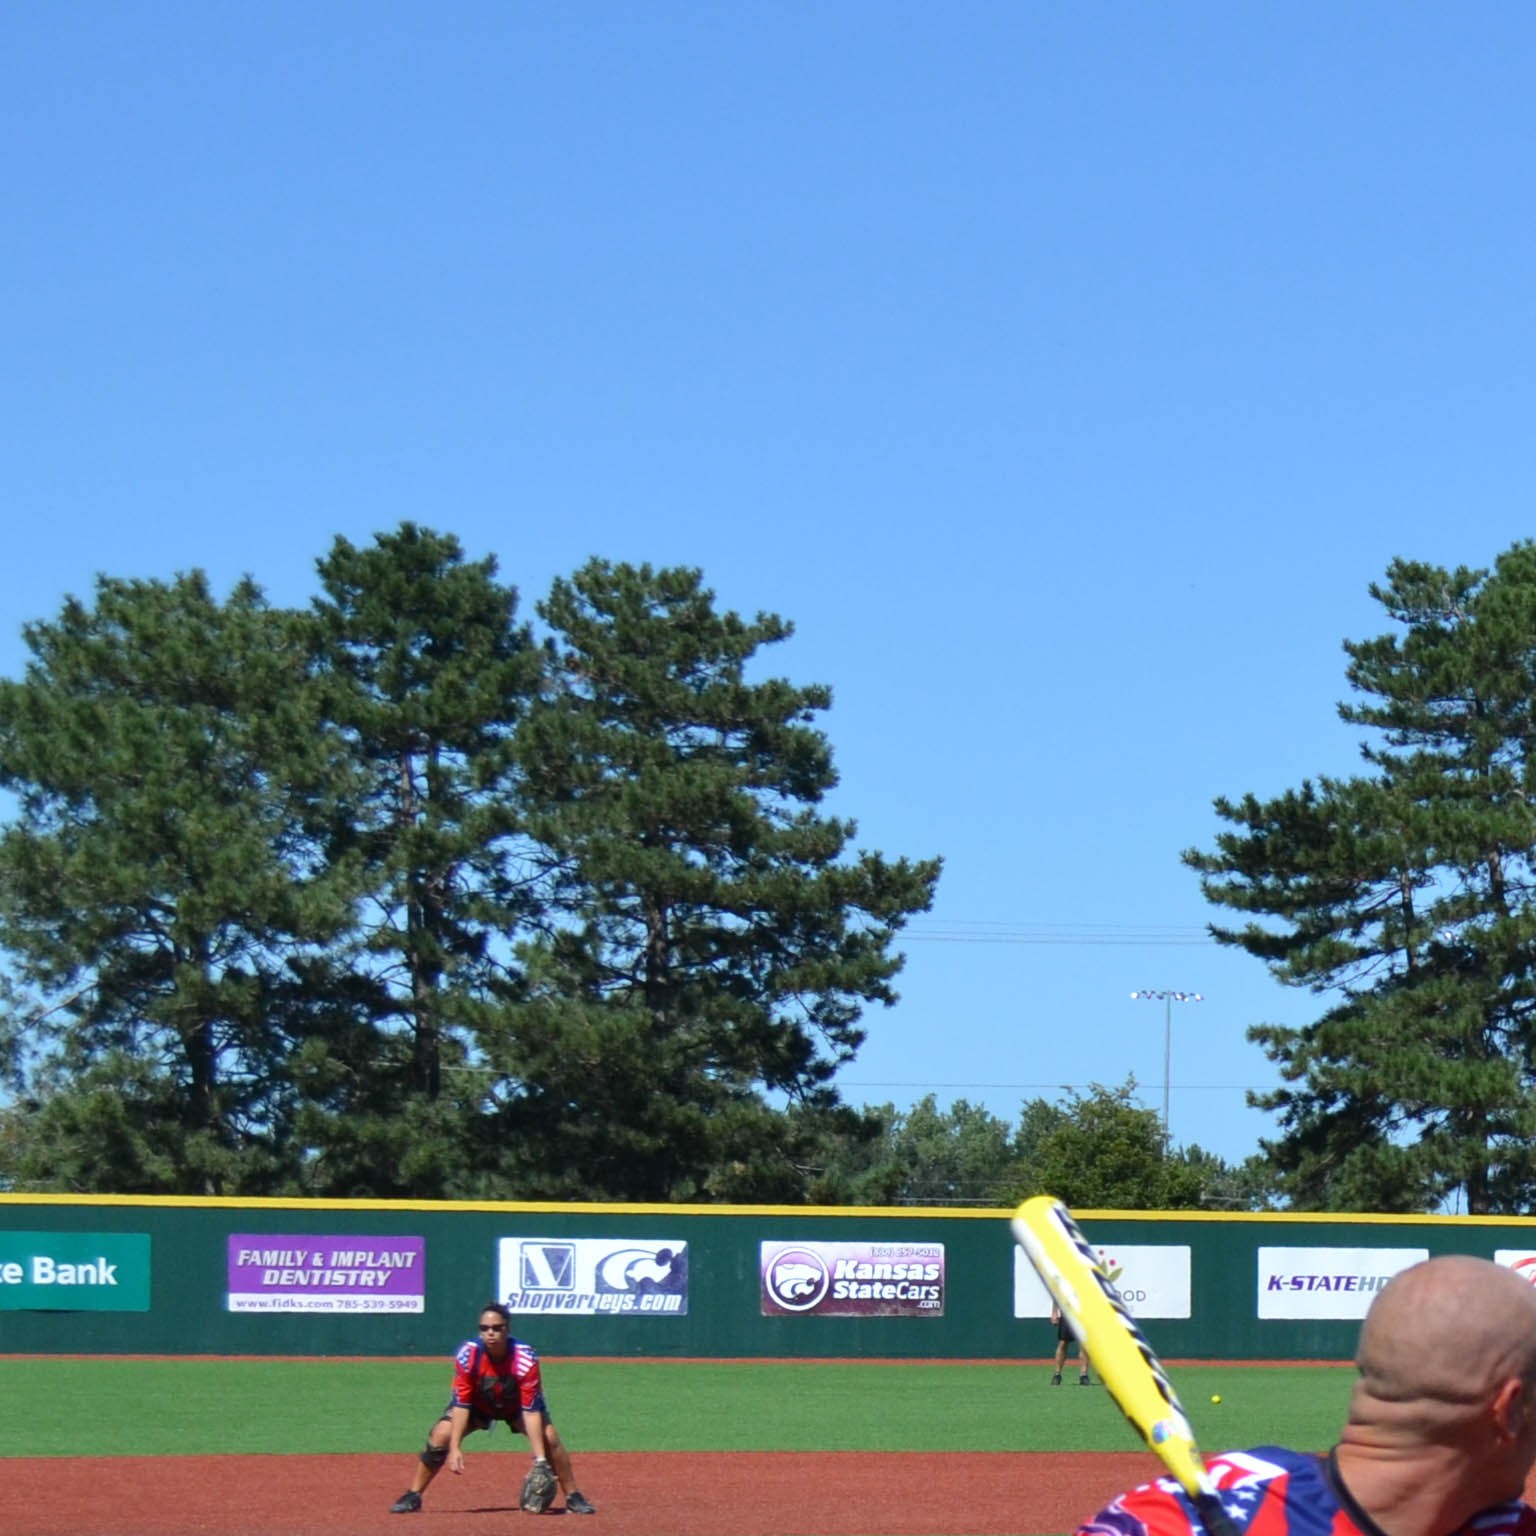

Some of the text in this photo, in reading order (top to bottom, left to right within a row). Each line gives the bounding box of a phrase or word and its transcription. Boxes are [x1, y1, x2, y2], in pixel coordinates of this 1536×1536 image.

[237, 1250, 417, 1269] FAMILY & IMPLANT
[32, 1256, 119, 1286] Bank
[262, 1269, 392, 1287] DENTISTRY
[832, 1259, 941, 1281] Kansas
[832, 1280, 941, 1300] StateCars
[917, 1300, 941, 1309] .com
